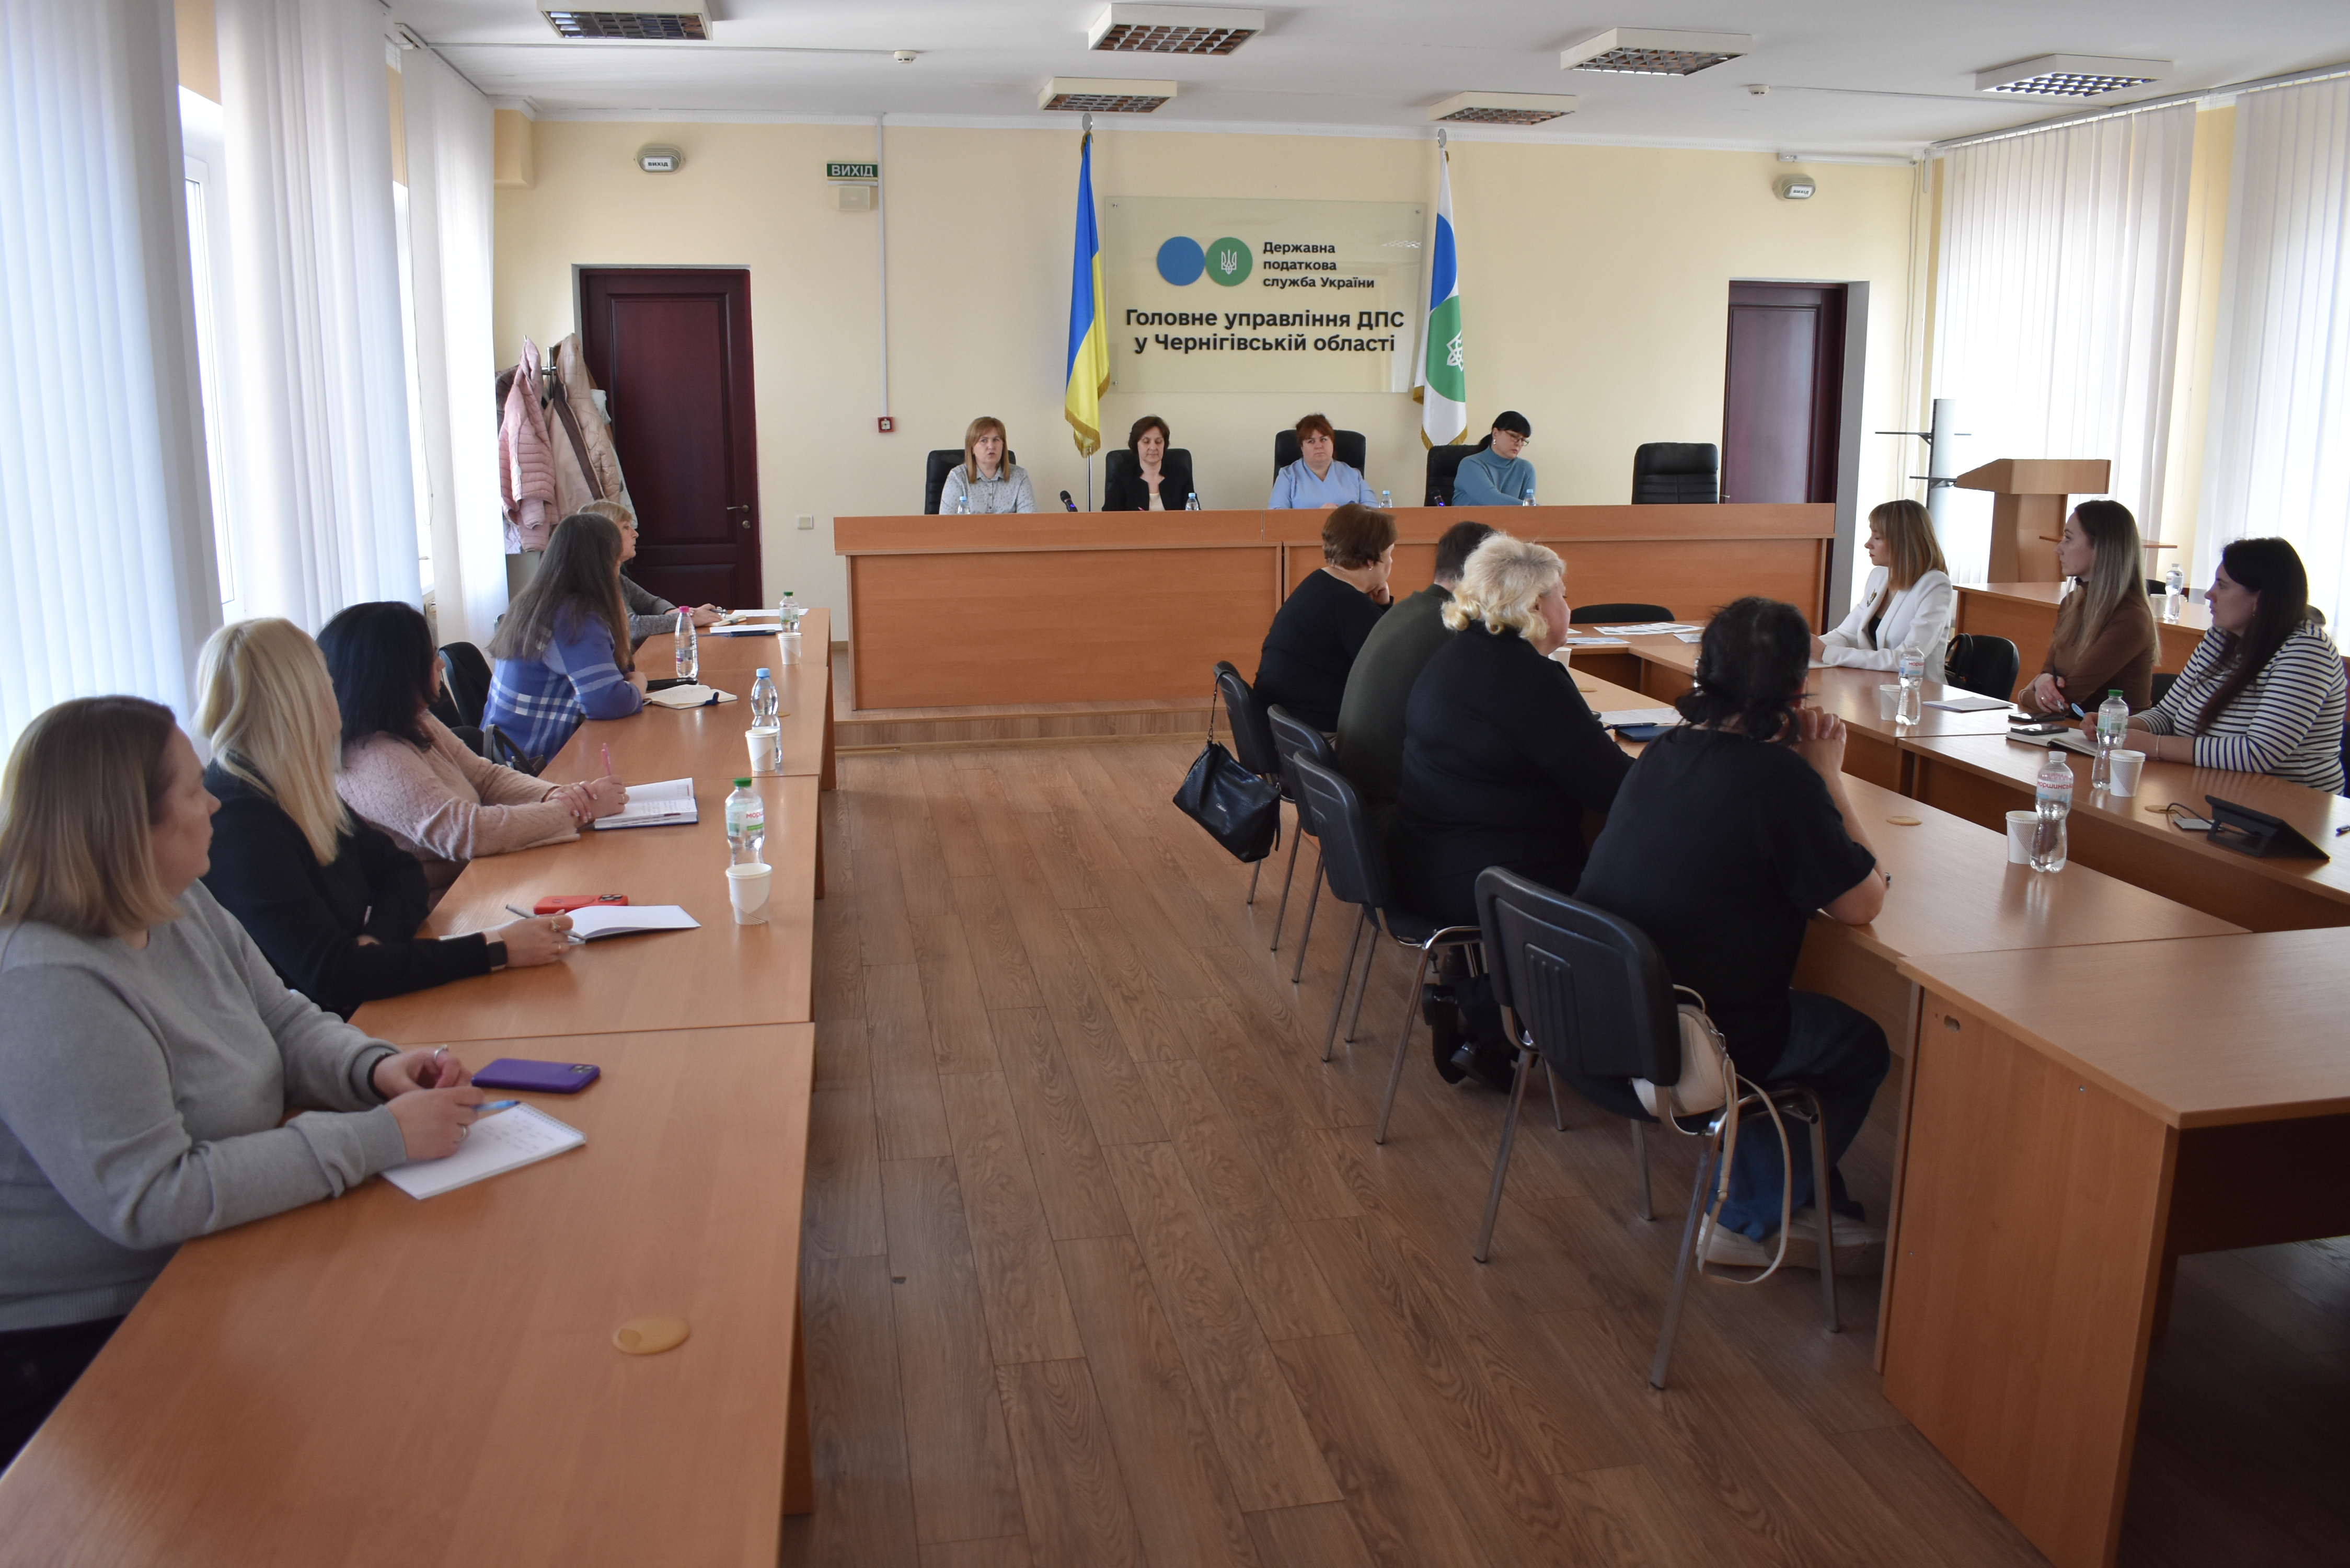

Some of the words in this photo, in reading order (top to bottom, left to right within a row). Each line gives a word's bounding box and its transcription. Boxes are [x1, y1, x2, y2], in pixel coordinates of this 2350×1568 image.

[832, 165, 873, 177] ВИХІД
[1263, 241, 1335, 255] Державна
[1263, 260, 1337, 272] податкова
[1263, 275, 1316, 289] служба
[1320, 276, 1374, 290] України
[1126, 309, 1217, 326] Головне
[1224, 309, 1350, 330] управління
[1357, 311, 1404, 331] ДПС
[1134, 337, 1148, 354] у
[1155, 333, 1306, 354] Чернігівській
[1314, 335, 1395, 352] області
